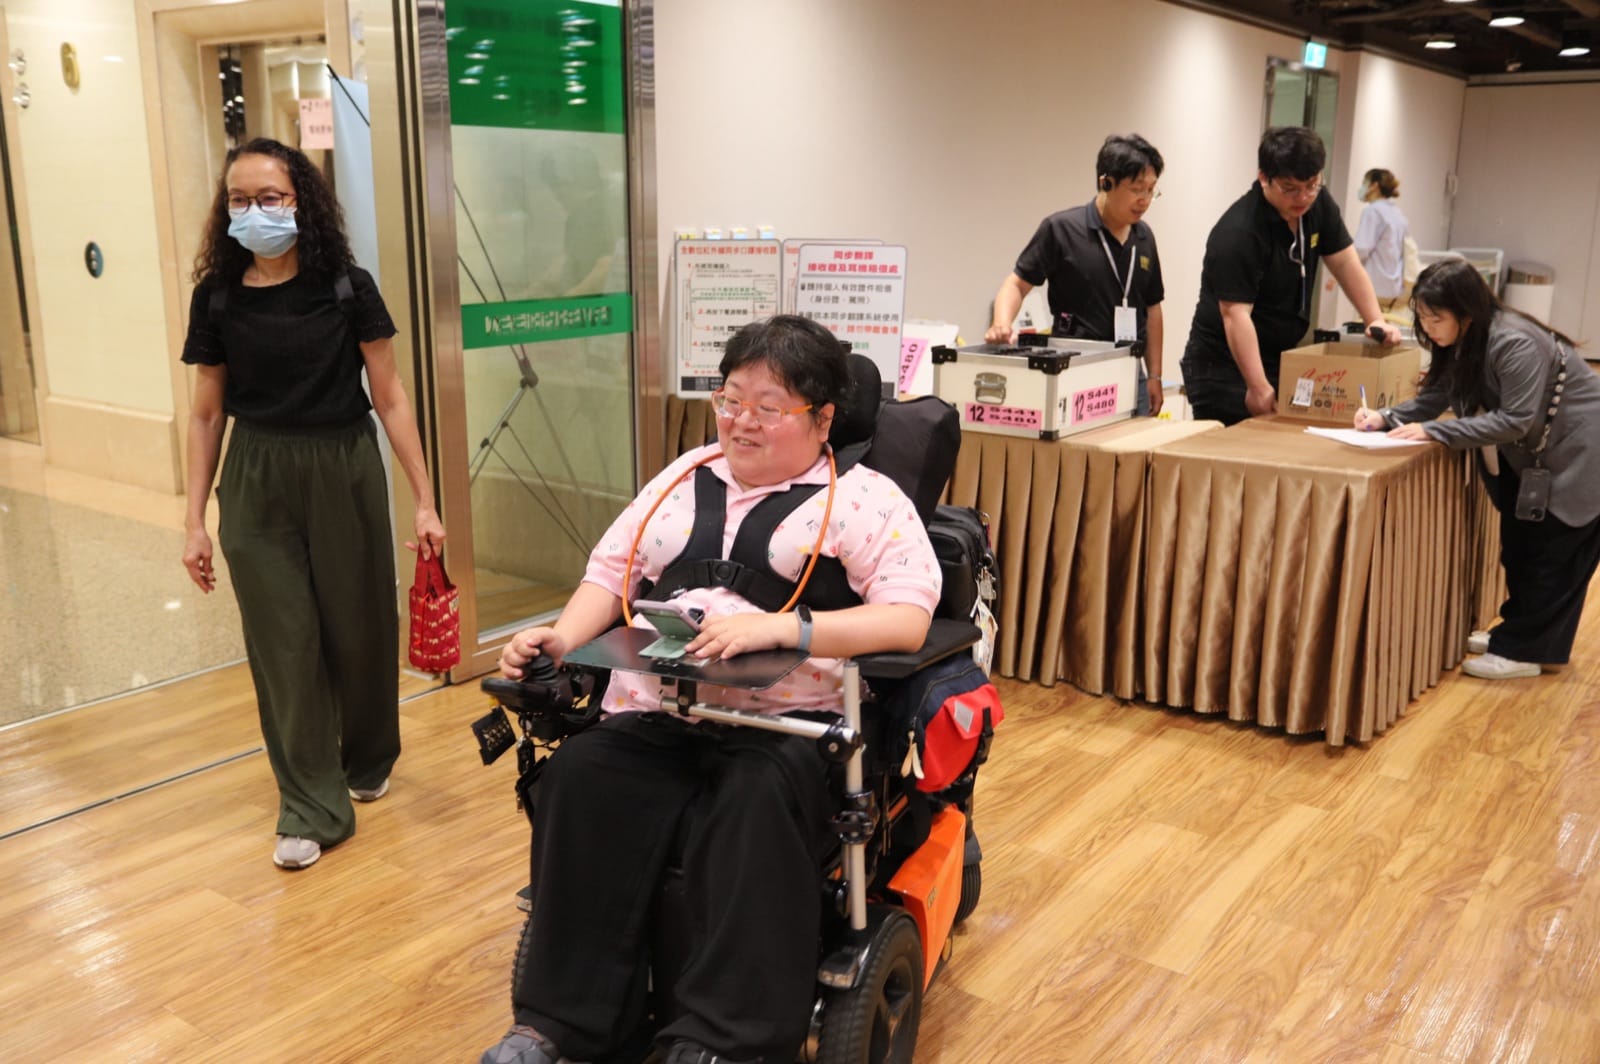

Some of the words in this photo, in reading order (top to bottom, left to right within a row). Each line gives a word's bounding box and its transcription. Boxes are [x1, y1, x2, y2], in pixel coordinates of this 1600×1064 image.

[833, 250, 873, 260] 同步翻譯
[1075, 393, 1084, 421] 12
[1088, 387, 1115, 400] S441
[1087, 399, 1115, 413] S480
[970, 405, 985, 422] 12
[989, 413, 1037, 425] S480
